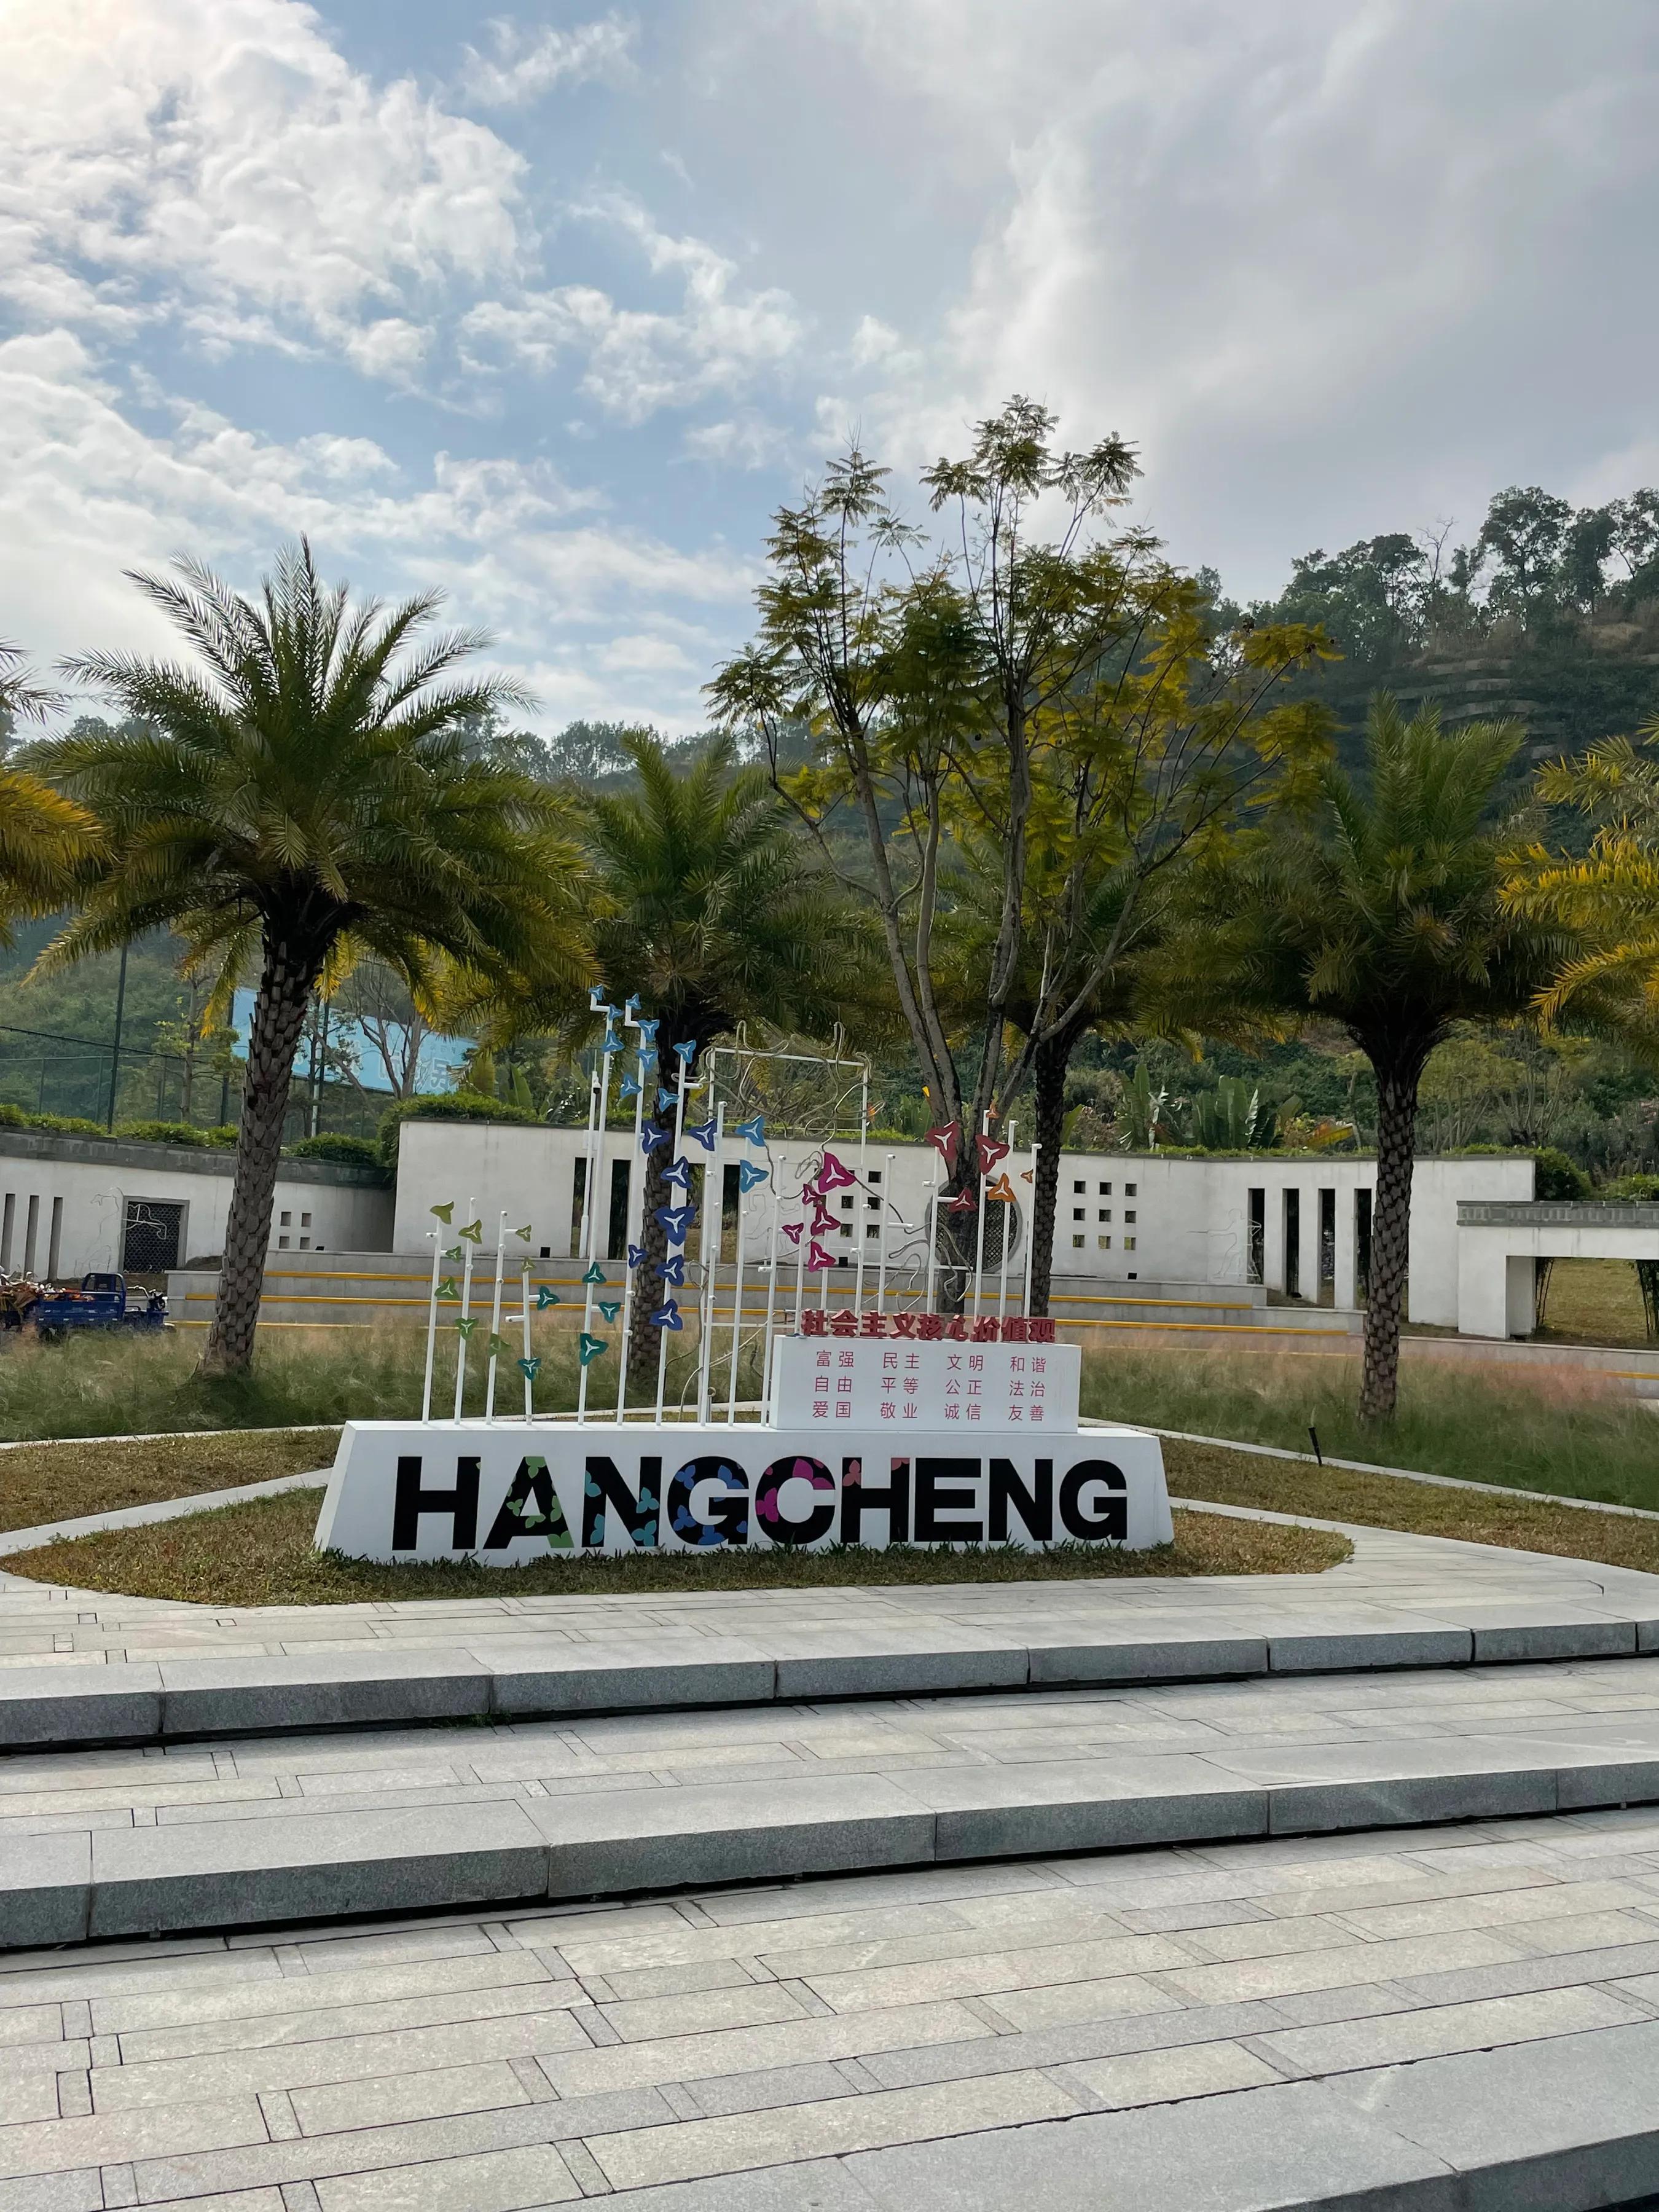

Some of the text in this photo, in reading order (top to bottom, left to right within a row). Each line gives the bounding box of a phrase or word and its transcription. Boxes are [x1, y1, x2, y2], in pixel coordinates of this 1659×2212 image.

[801, 1308, 1056, 1343] 社会主义核心价值观
[816, 1350, 1046, 1373] 富强 民主 文明 和谐
[814, 1376, 1045, 1397] 自由 平等 公正 法治
[812, 1400, 1045, 1422] 爱国 敬业 诚信 友善
[391, 1456, 1127, 1550] HANGCHENG
